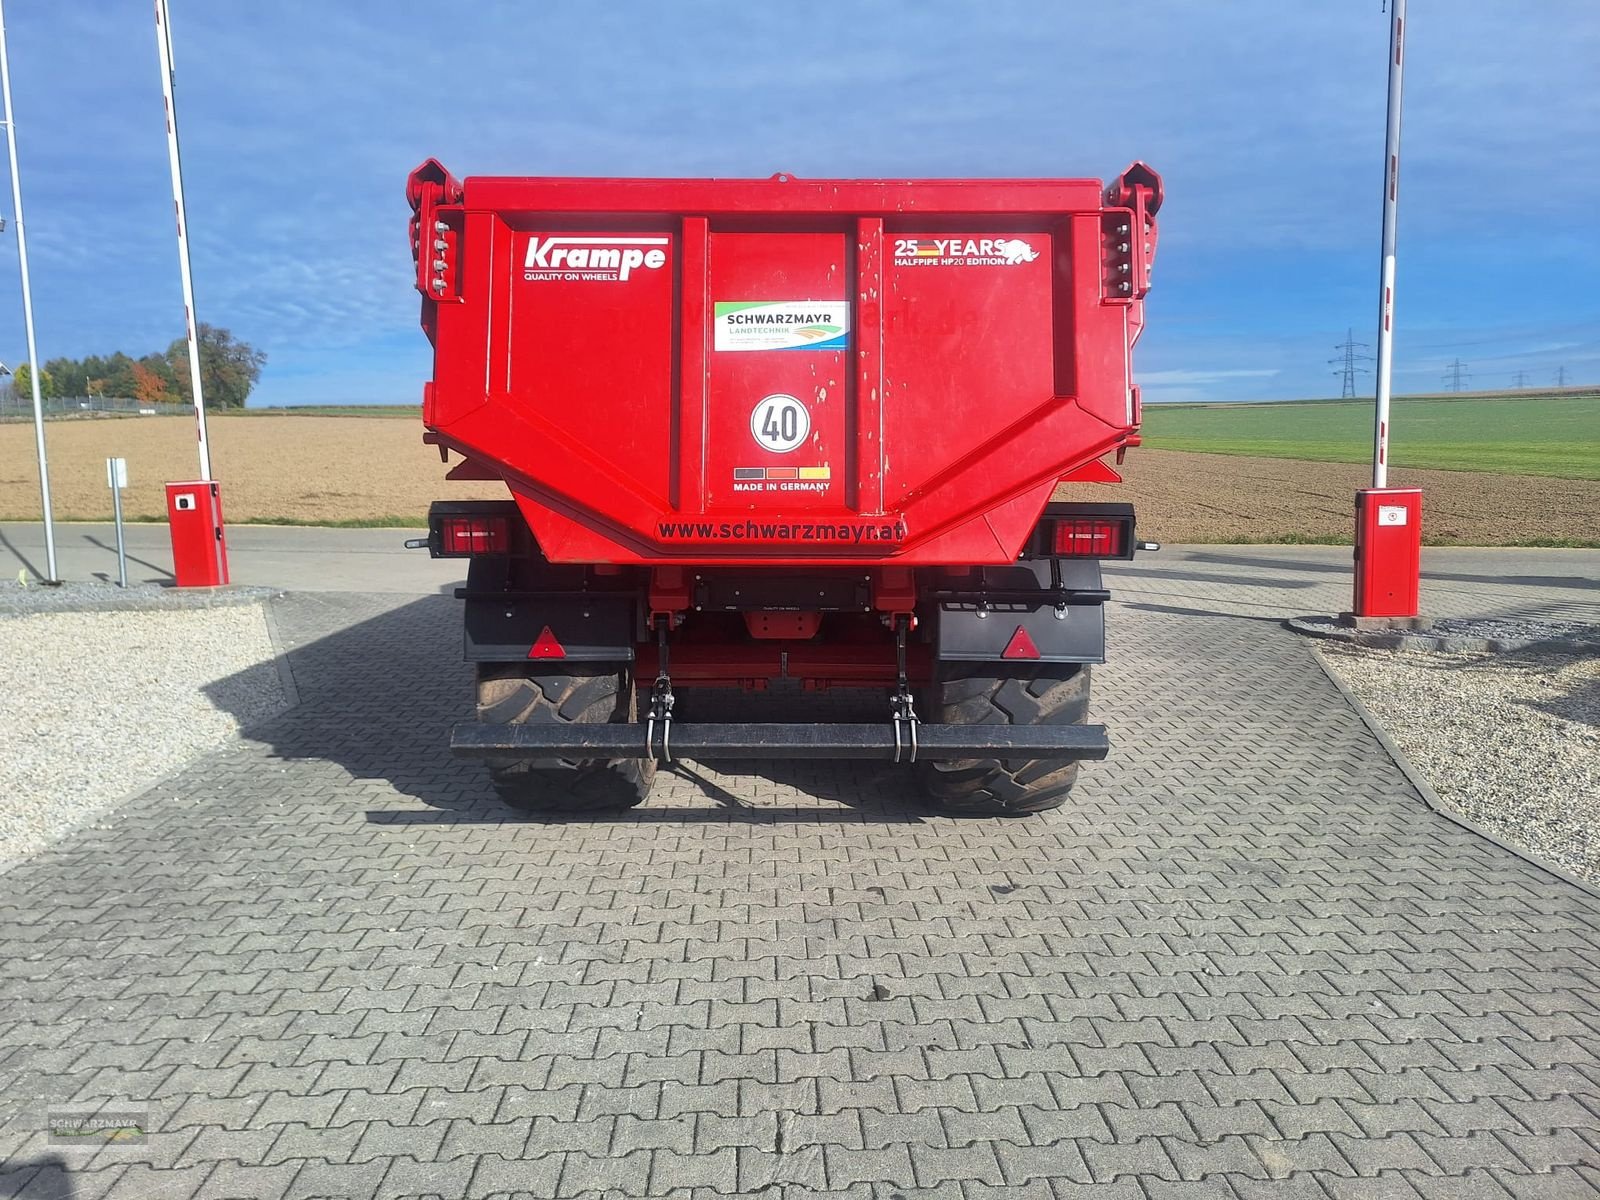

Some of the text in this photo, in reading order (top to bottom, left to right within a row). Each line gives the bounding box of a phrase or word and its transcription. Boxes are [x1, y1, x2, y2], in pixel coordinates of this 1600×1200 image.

[894, 239, 1006, 256] 25 YEARS
[524, 237, 669, 281] Krampe
[894, 258, 1005, 266] HALFPIPE HP20 EDITION
[524, 273, 617, 281] QUALITY ON WHEELS
[727, 314, 832, 324] SCHWARZMAYR
[761, 405, 798, 442] 40
[733, 482, 830, 491] MADE IN GERMANY
[658, 520, 905, 544] www.schwarzmayr.at
